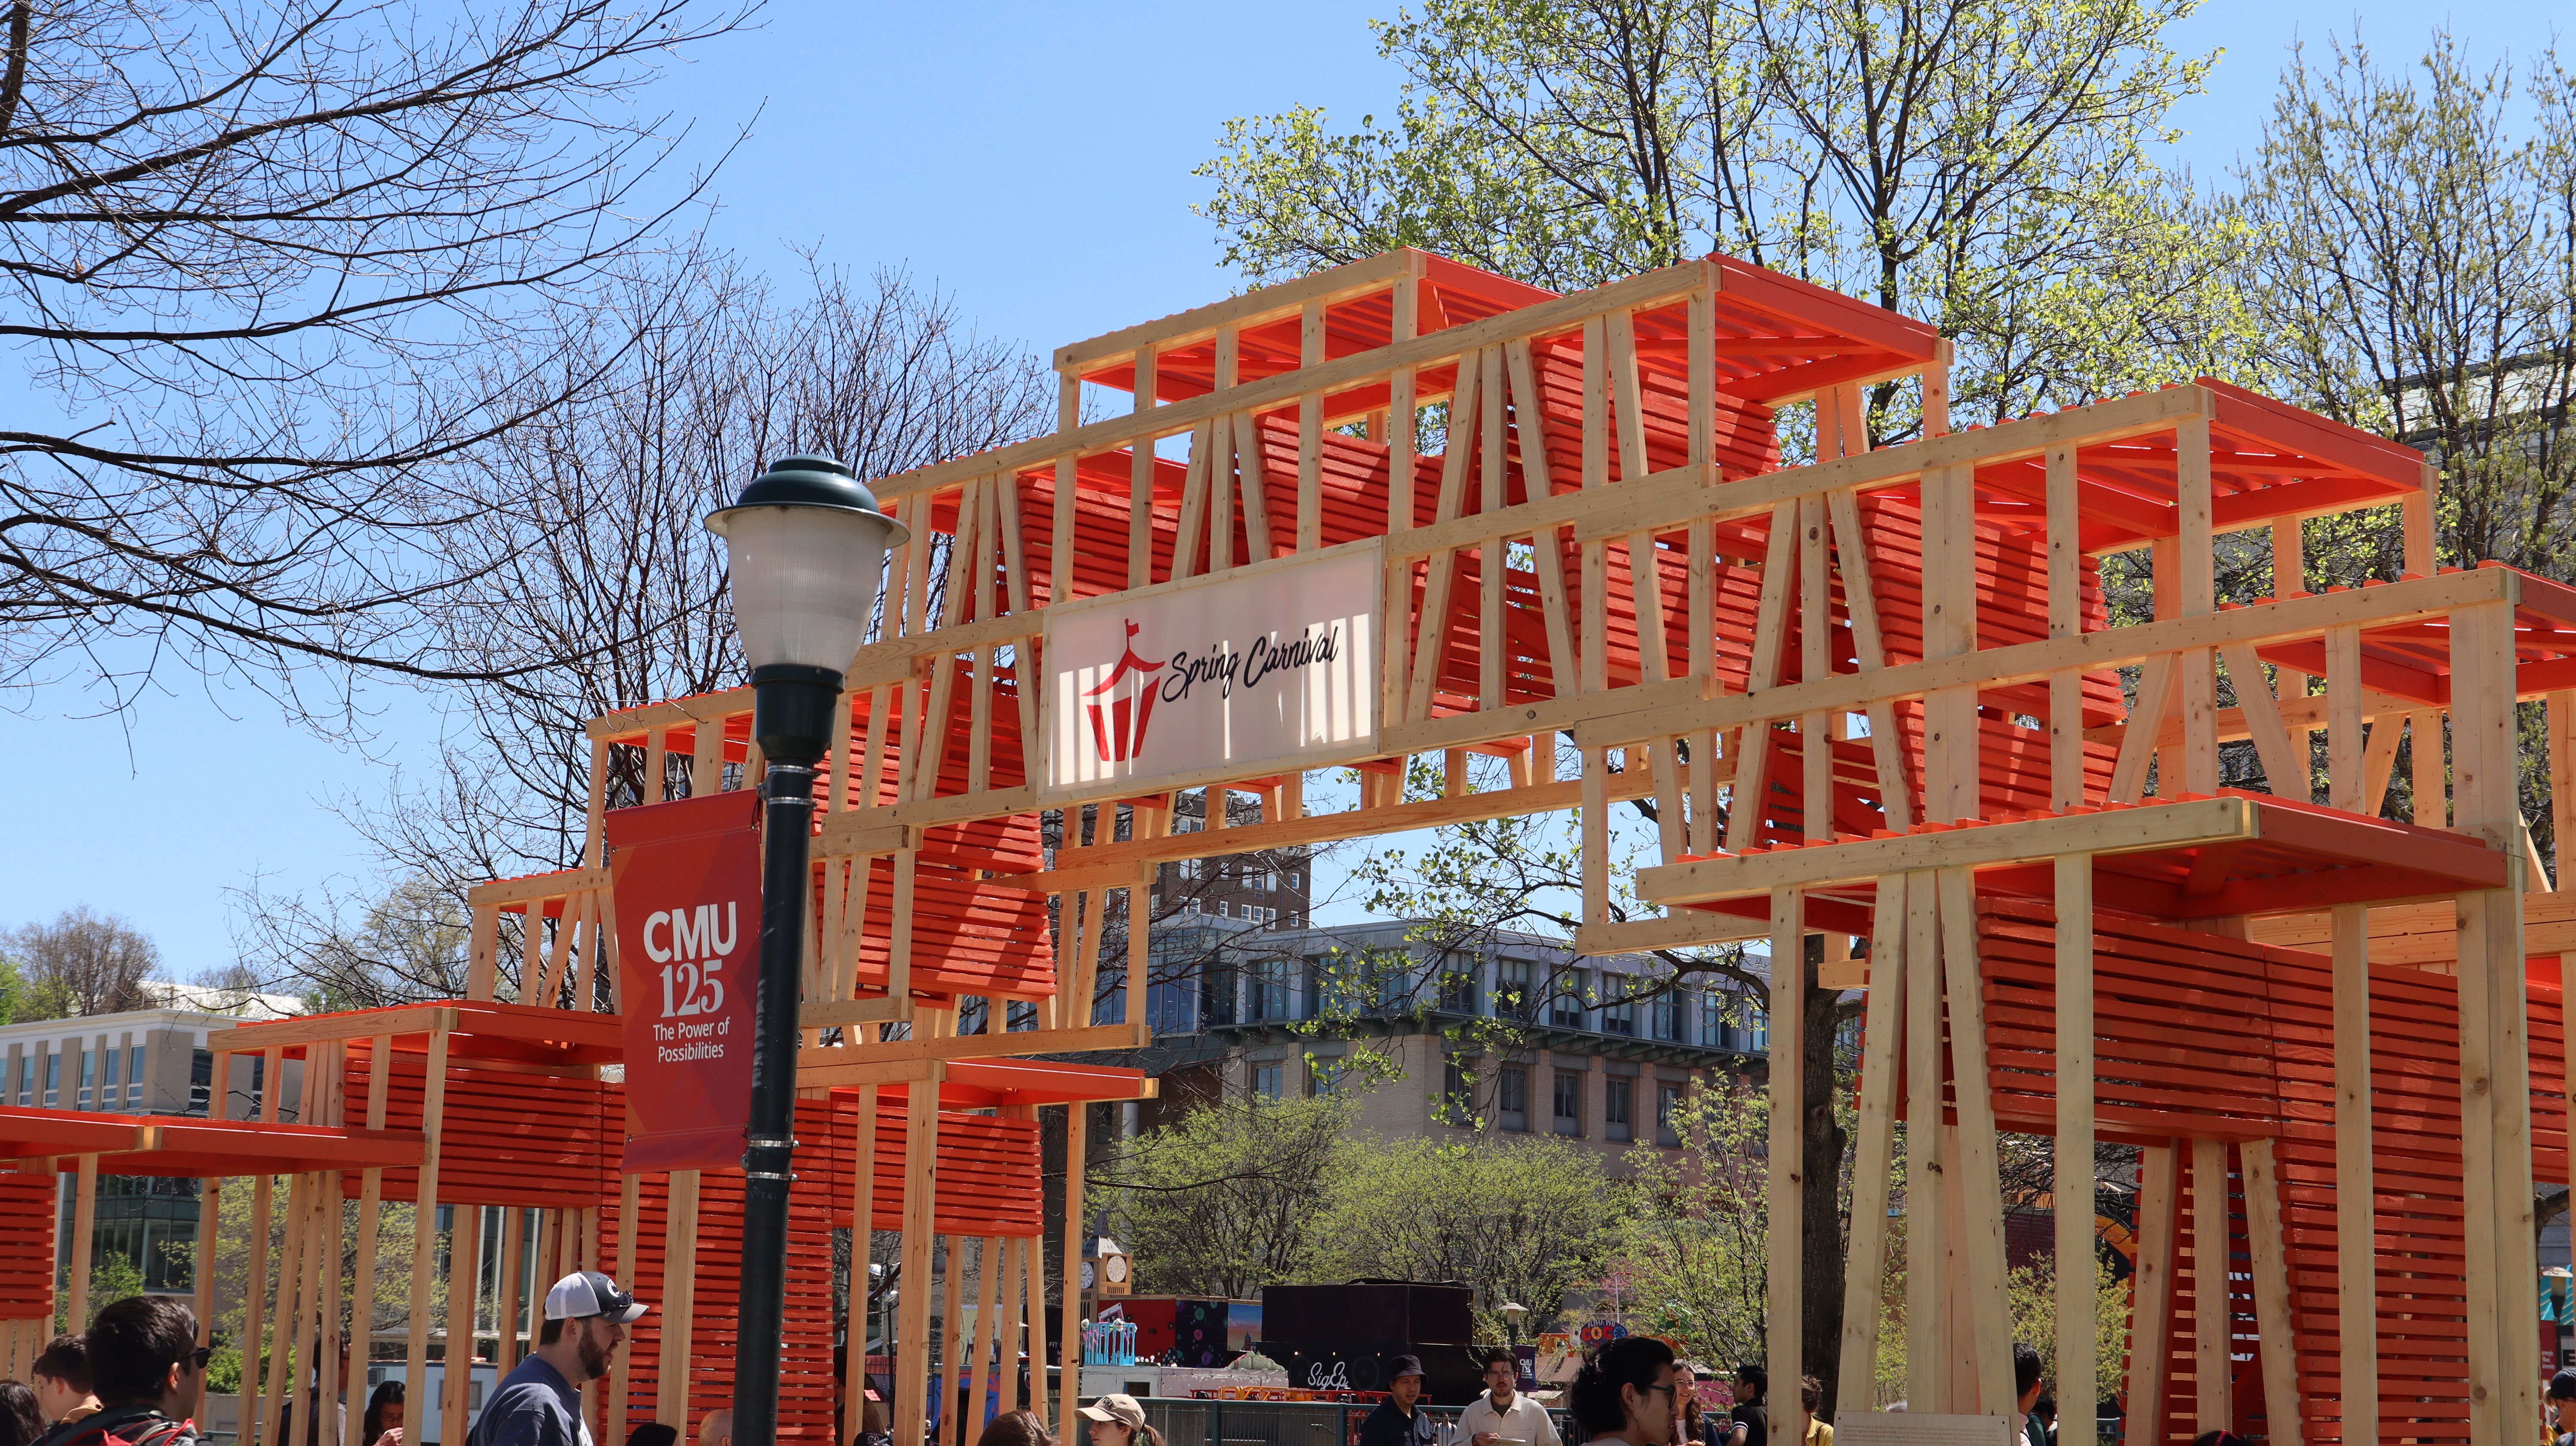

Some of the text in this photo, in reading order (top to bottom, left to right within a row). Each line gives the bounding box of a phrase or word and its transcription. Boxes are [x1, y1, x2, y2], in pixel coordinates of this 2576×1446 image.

[1162, 626, 1338, 703] Spring Carnival
[643, 901, 737, 963] CMU
[659, 959, 724, 1018] 125
[653, 1016, 730, 1041] The Power of
[658, 1041, 724, 1063] Possibilities
[1588, 1320, 1604, 1328] ALPHA
[1307, 1361, 1349, 1391] SigEp
